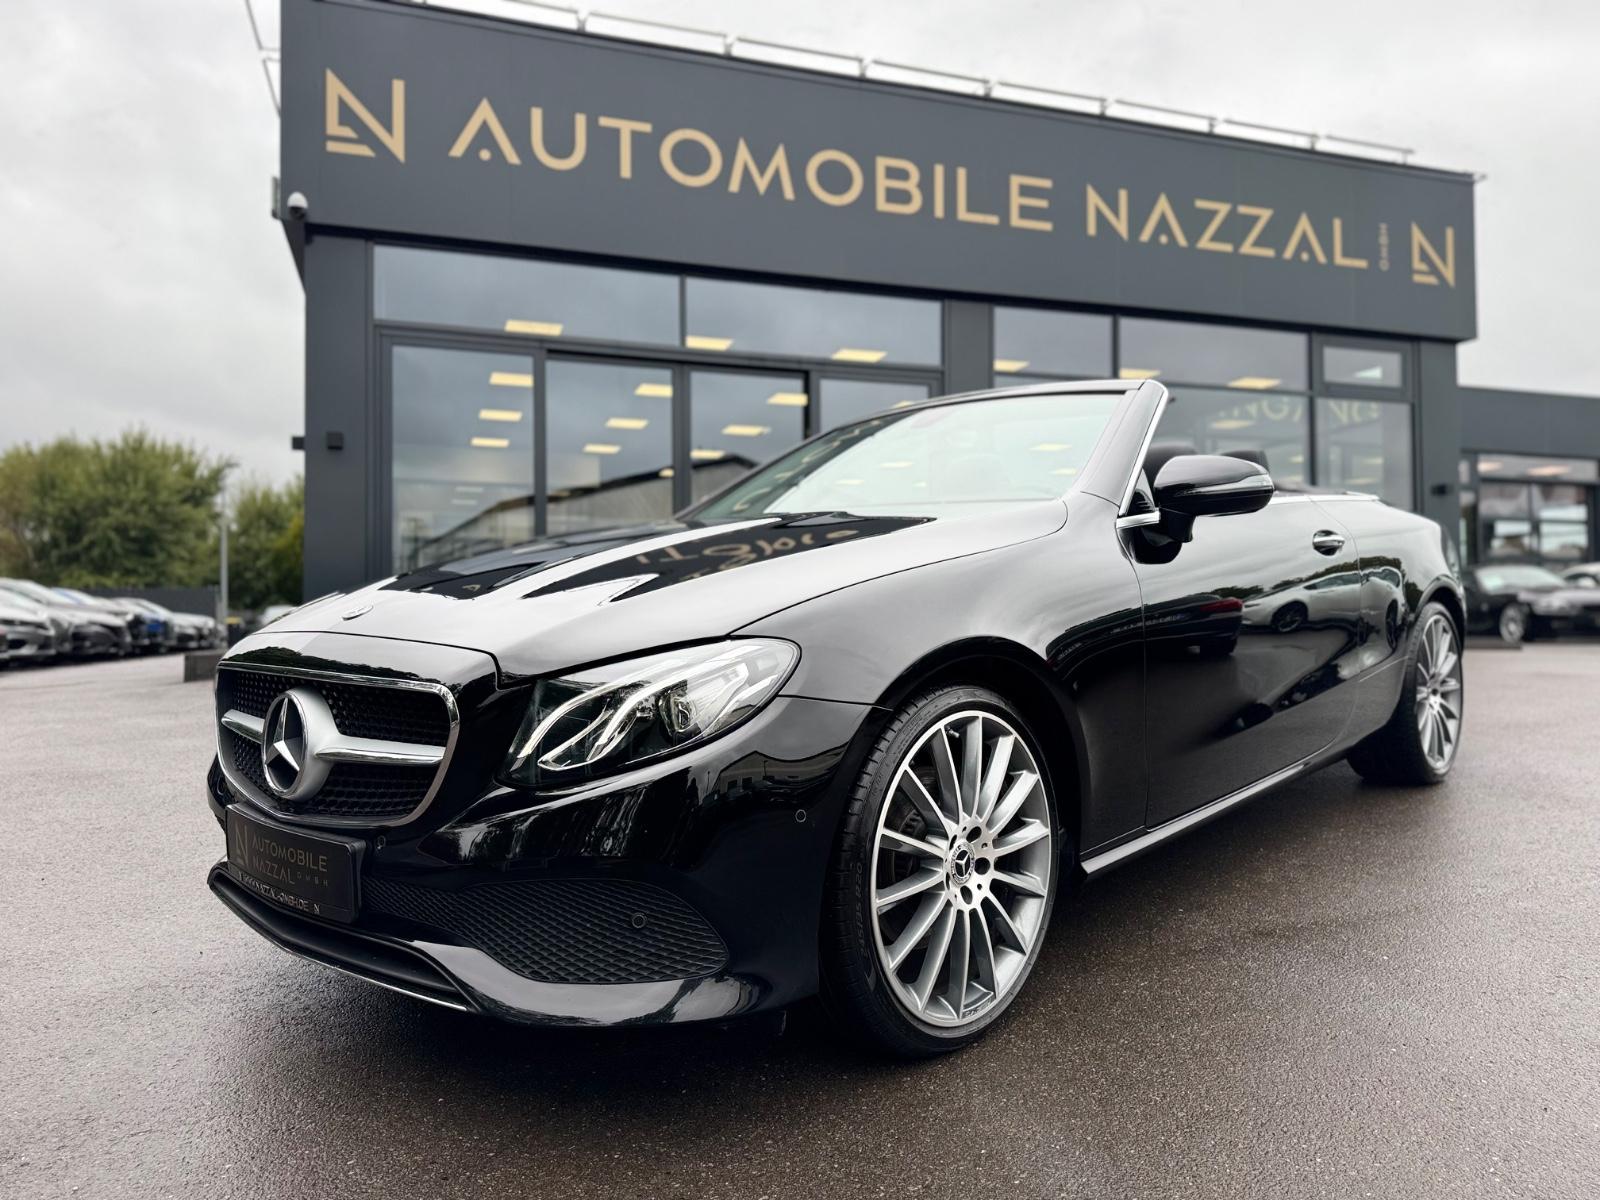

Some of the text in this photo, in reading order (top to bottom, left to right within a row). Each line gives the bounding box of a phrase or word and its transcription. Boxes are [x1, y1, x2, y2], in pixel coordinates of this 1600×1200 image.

[448, 97, 1054, 232] AUTOMOBILE
[1087, 183, 1368, 269] NAZZAL
[251, 835, 328, 872] AUTOMOBILE
[252, 856, 295, 885] NAZZAL
